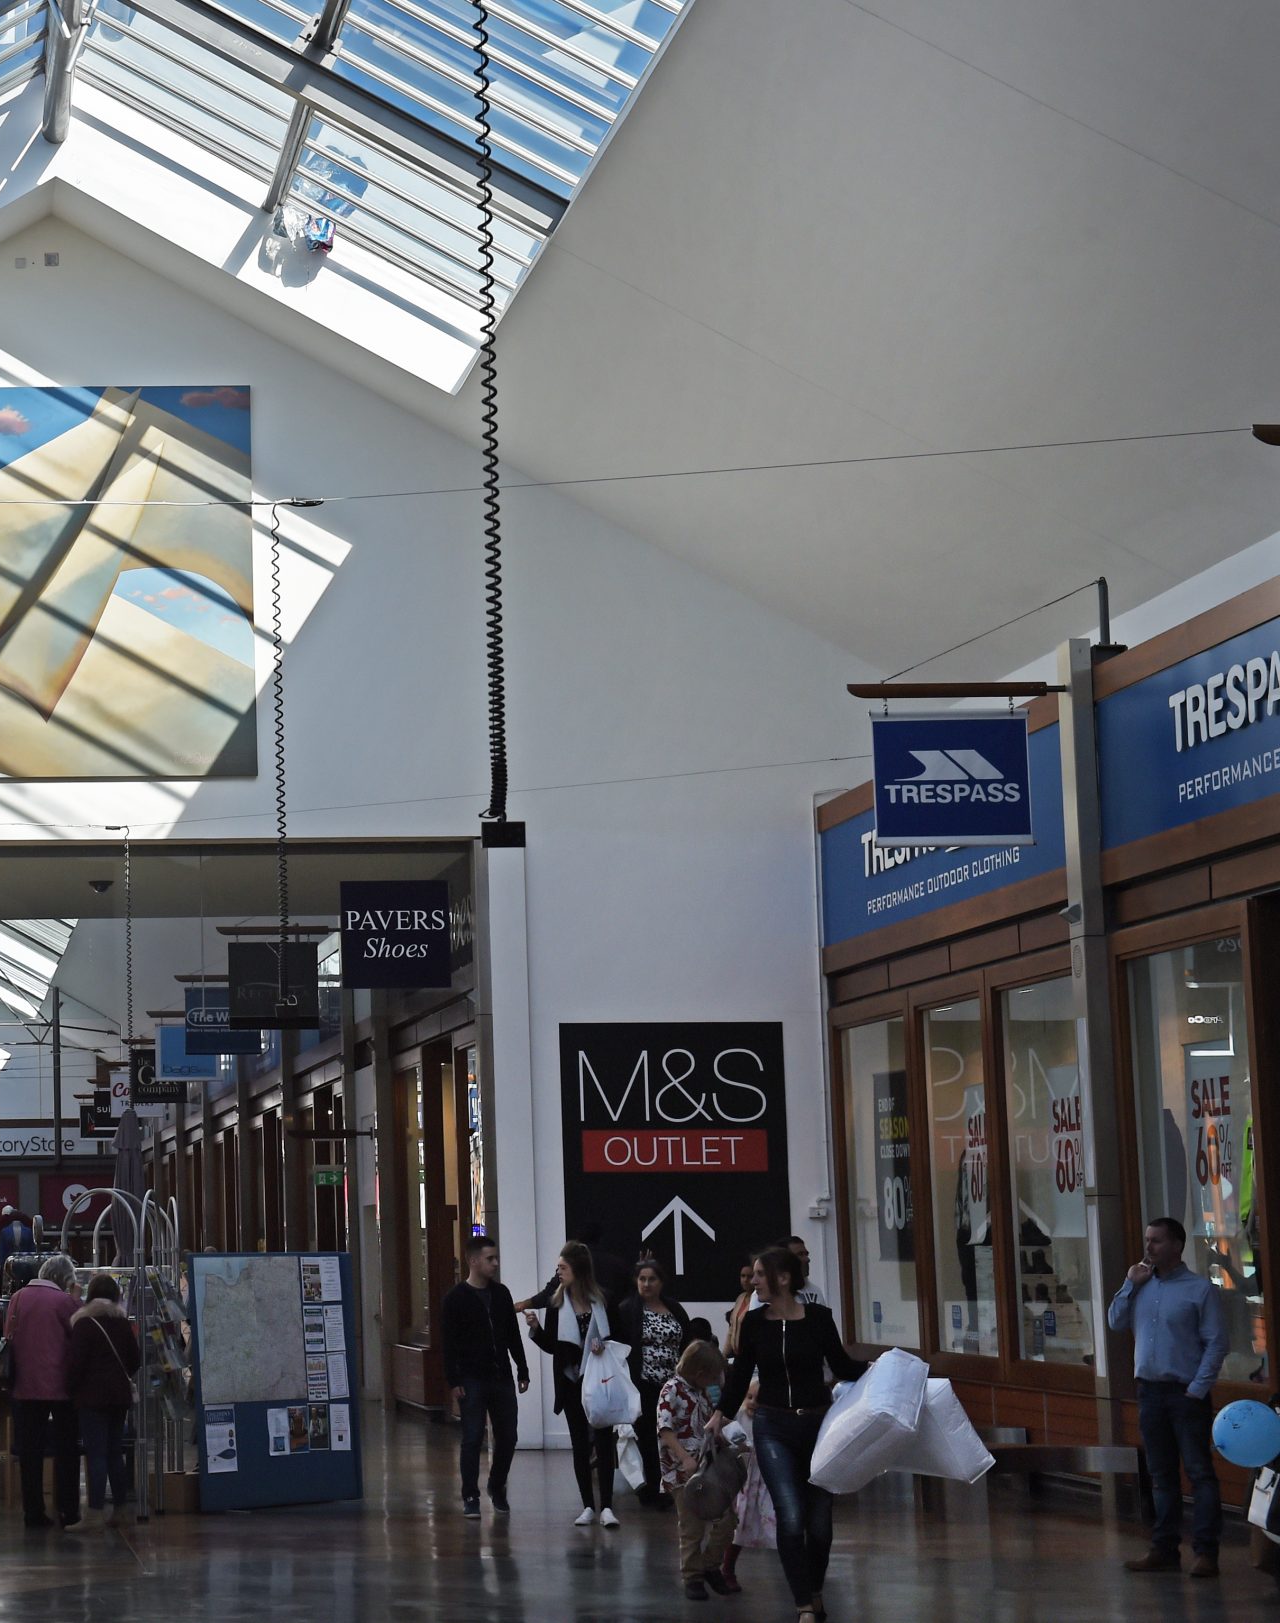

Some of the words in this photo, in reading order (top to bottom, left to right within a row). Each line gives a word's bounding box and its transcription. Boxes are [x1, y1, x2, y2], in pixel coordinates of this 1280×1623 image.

[1178, 748, 1280, 803] PERFORMANCE
[884, 783, 1021, 804] TRESPASS
[867, 881, 925, 915] PERFORMANCE
[927, 864, 970, 894] OUTDOOR
[972, 846, 1020, 877] CLOTHING
[345, 910, 445, 931] PAVERS
[363, 937, 428, 958] Shoes
[192, 1012, 214, 1022] The
[578, 1048, 767, 1122] M&S
[1191, 1076, 1231, 1119] SALE
[879, 1116, 910, 1140] SEASON
[968, 1114, 987, 1148] SAL
[604, 1136, 743, 1165] OUTLET
[1196, 1124, 1232, 1186] 60%
